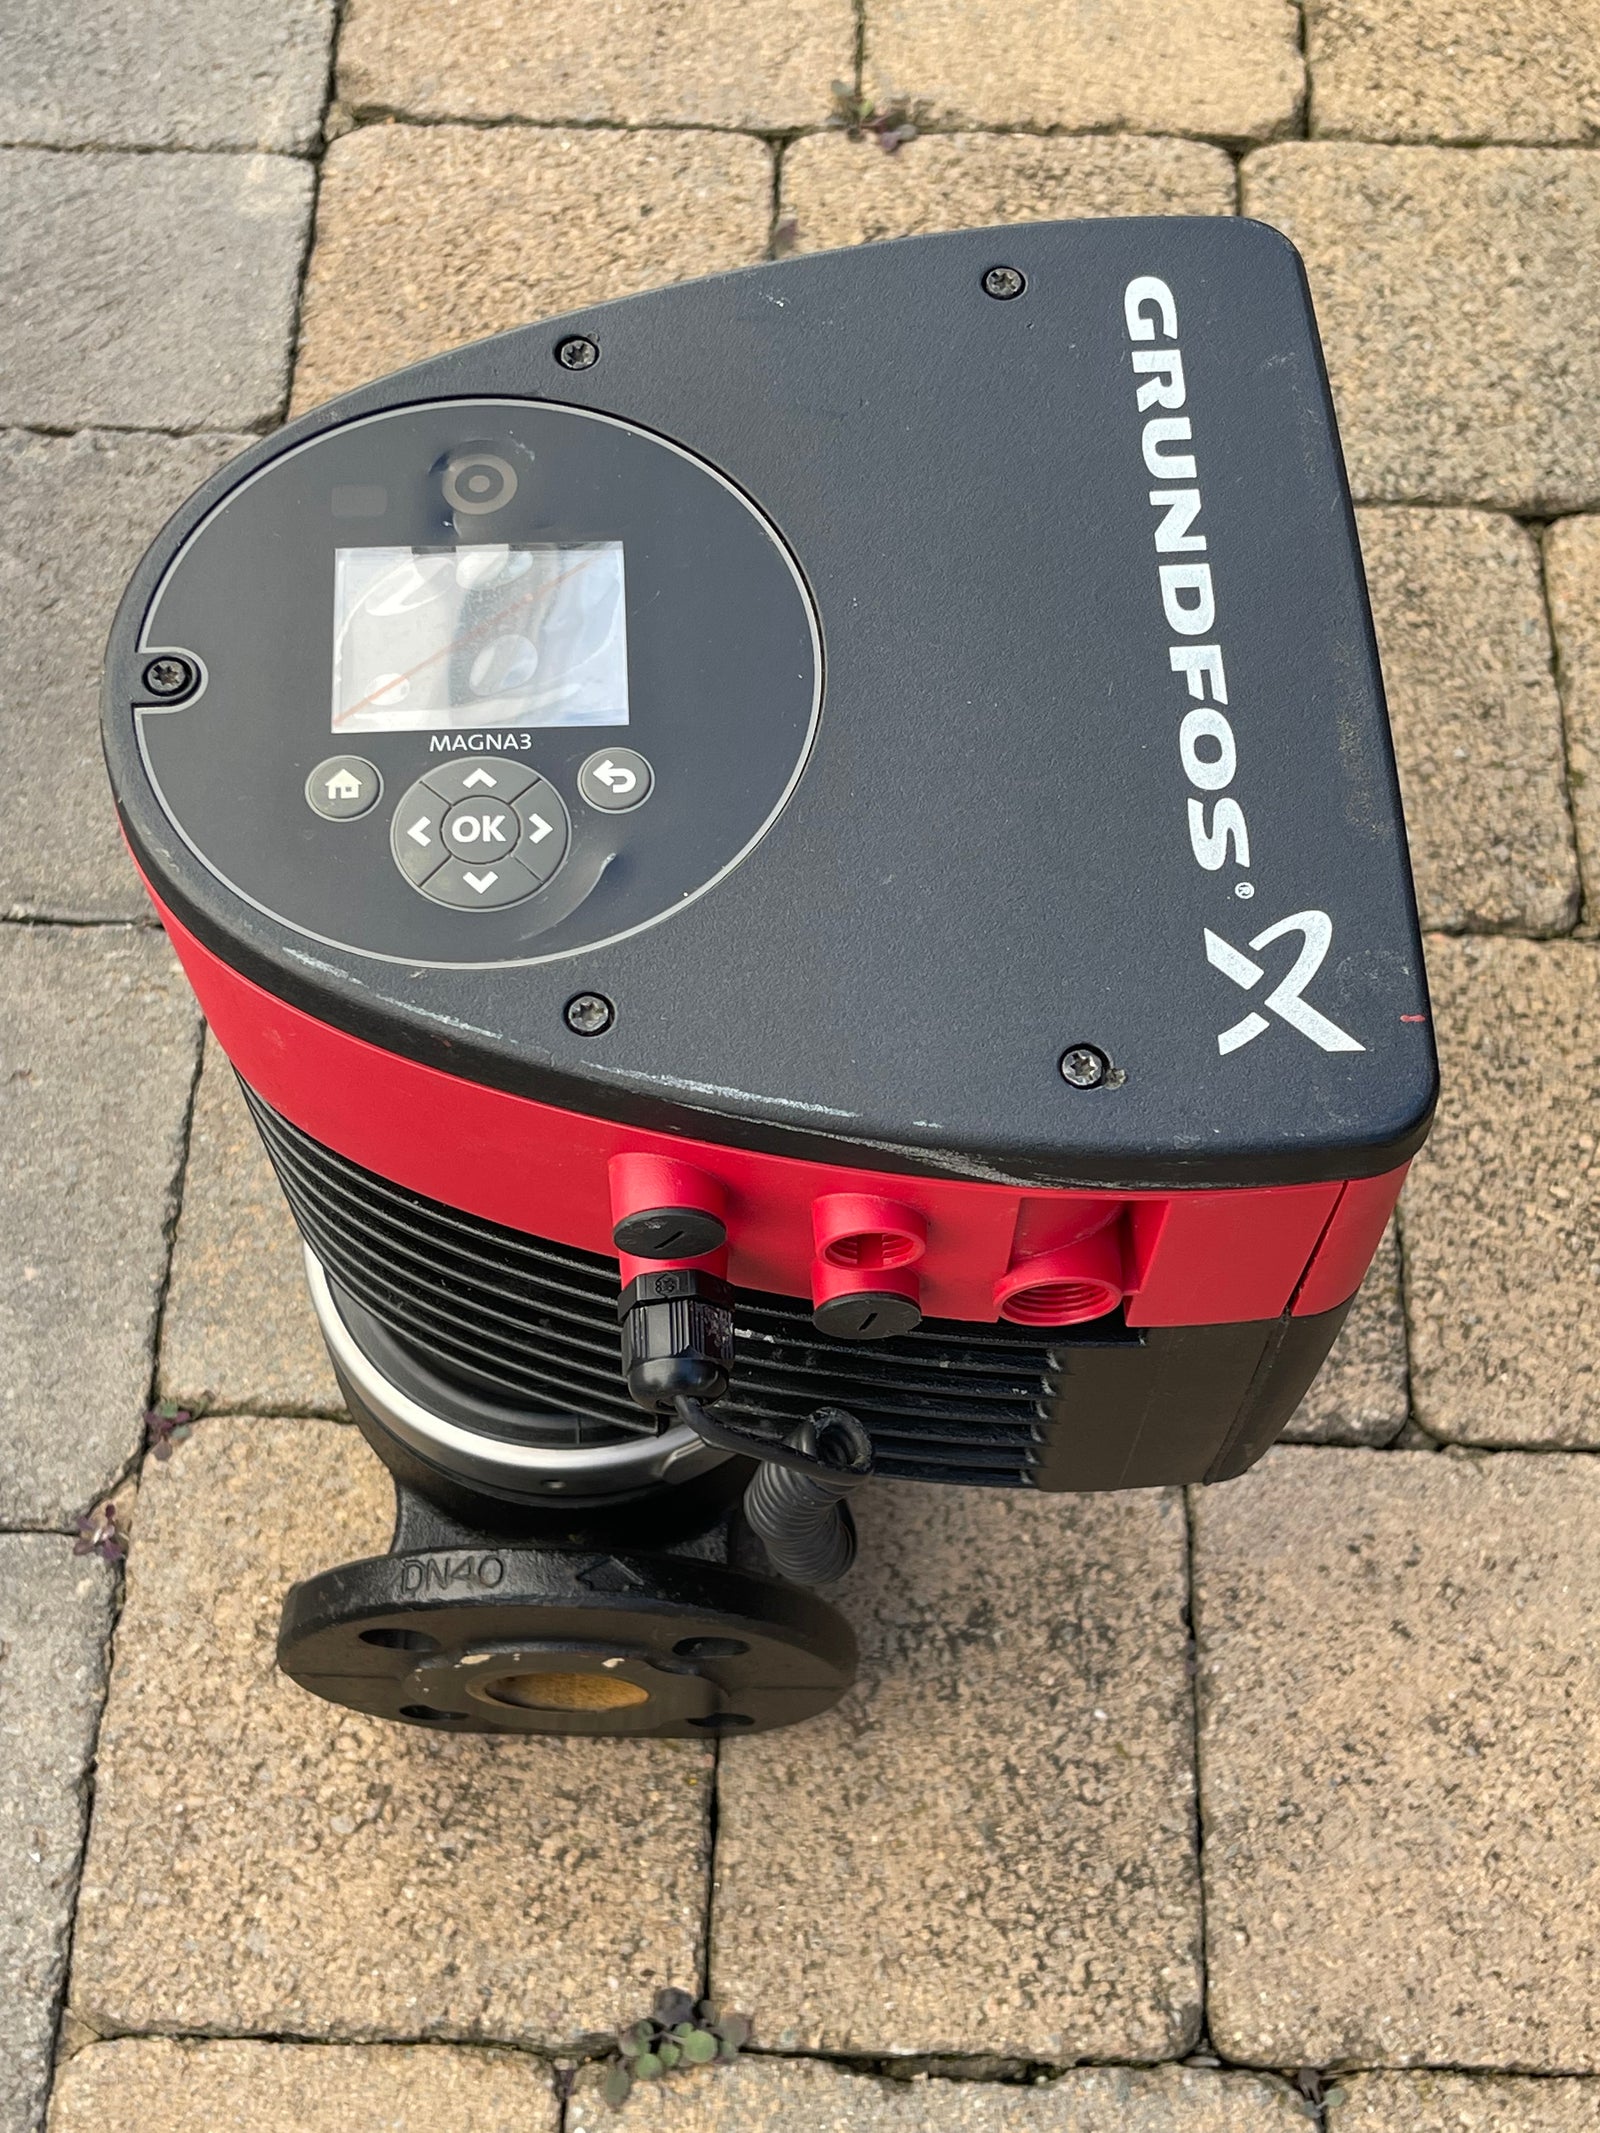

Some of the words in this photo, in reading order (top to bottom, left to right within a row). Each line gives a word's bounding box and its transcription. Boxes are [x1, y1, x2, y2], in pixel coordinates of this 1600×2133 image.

[429, 733, 532, 752] MAGNA3
[451, 815, 506, 843] OK
[400, 1554, 504, 1593] DN40
